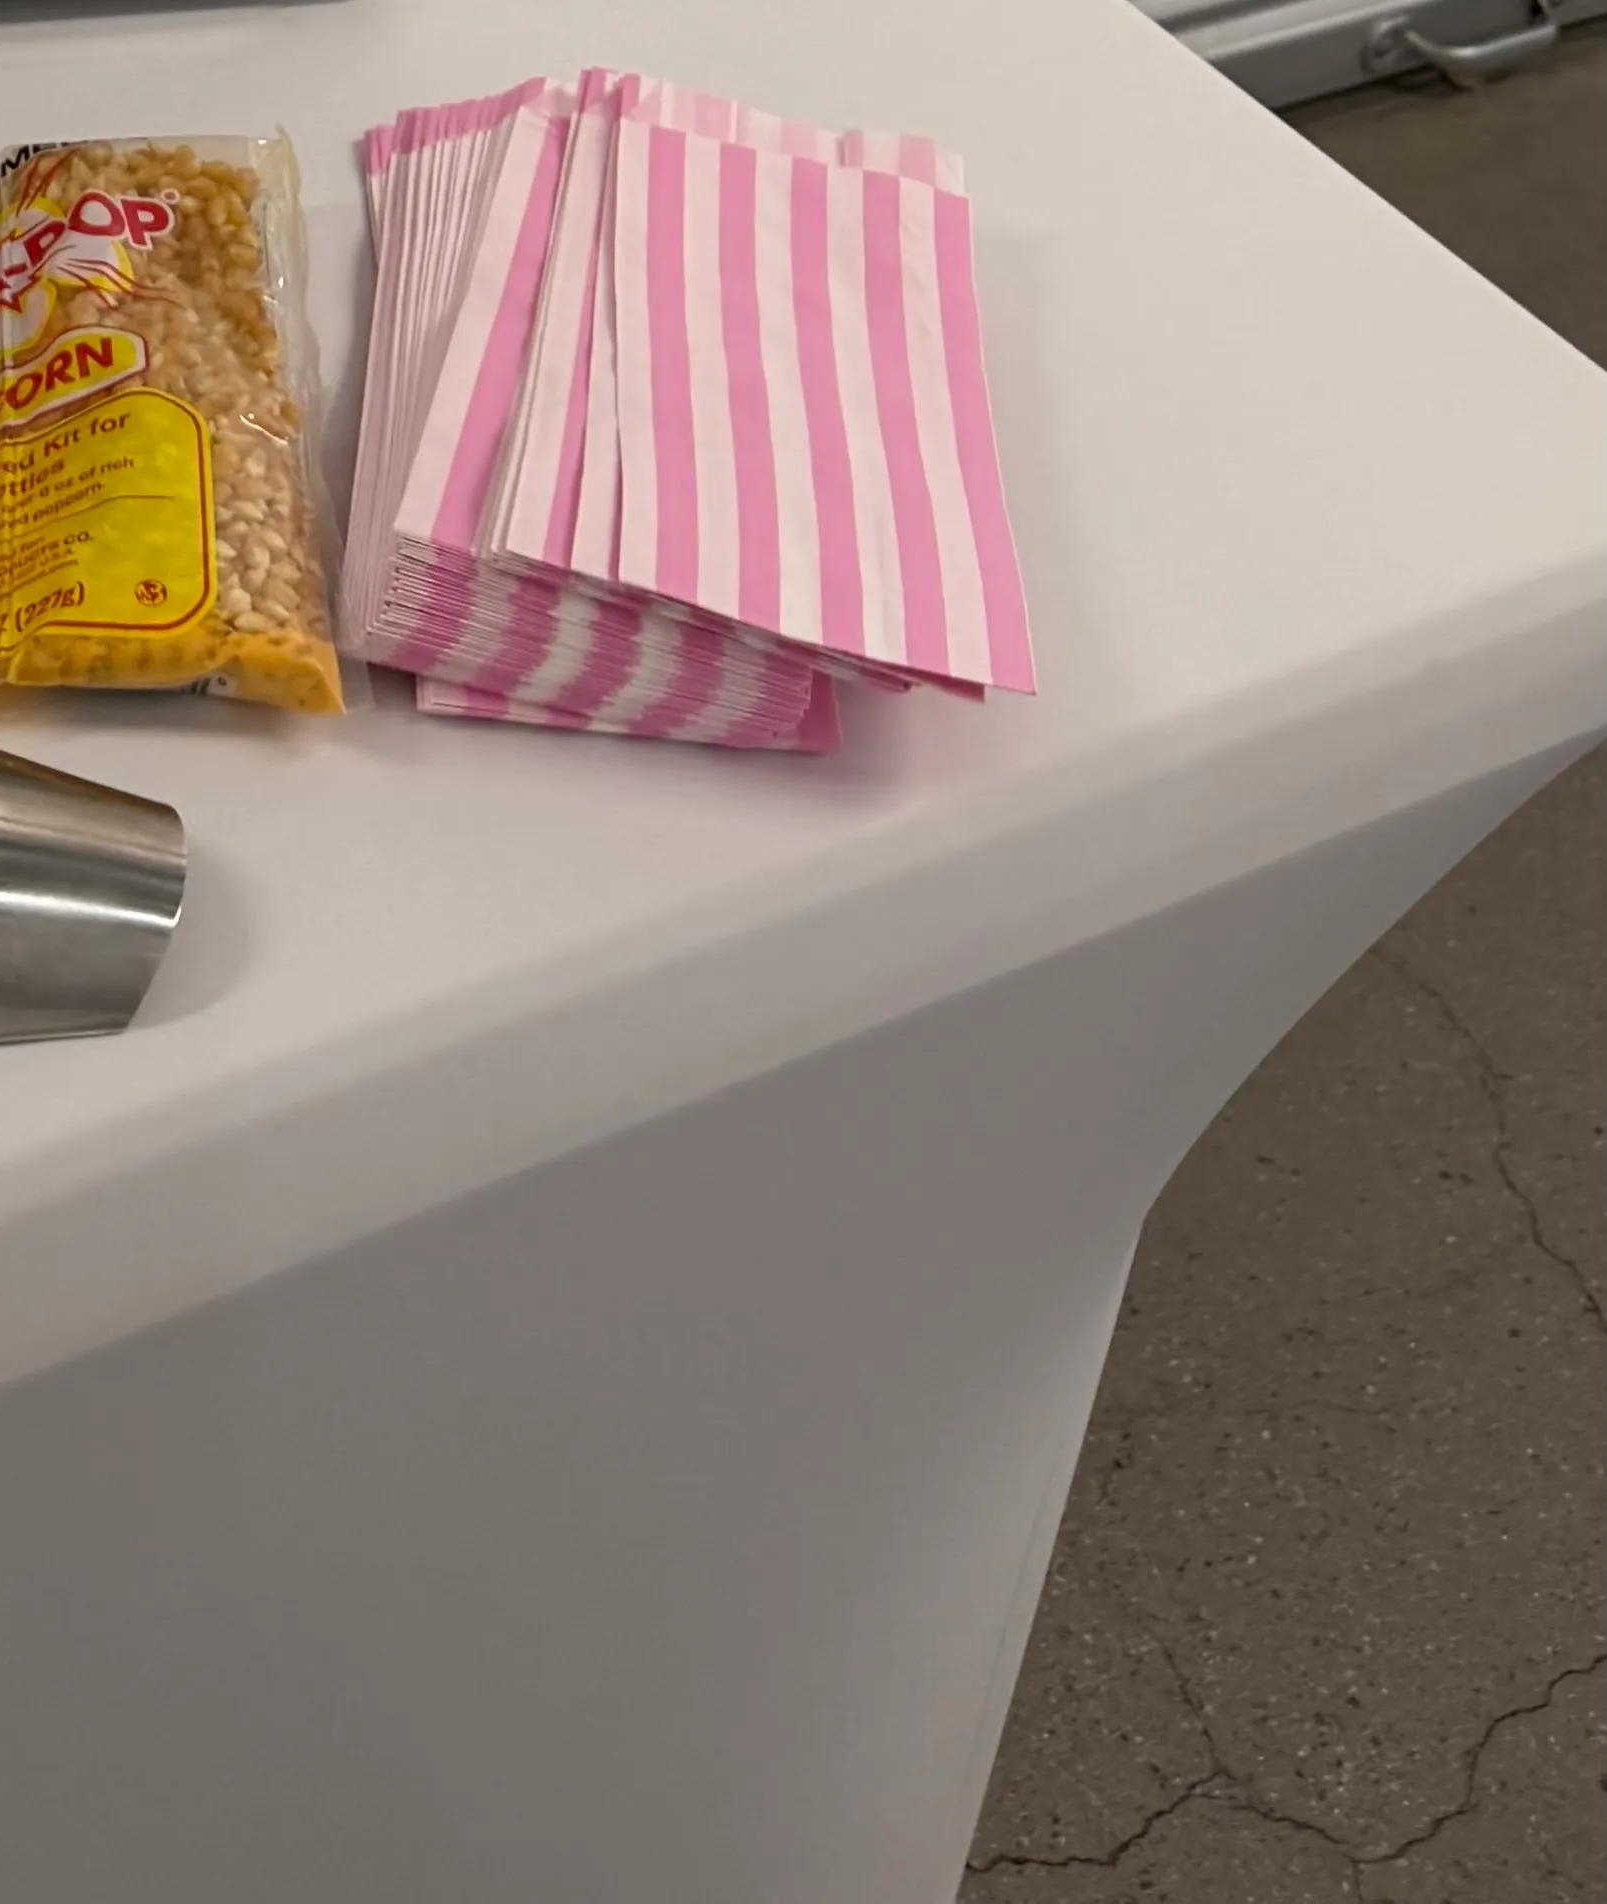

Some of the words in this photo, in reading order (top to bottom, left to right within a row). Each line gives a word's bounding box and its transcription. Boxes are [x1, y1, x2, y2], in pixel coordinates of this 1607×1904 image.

[43, 428, 81, 457] Kit
[90, 413, 131, 436] for
[15, 580, 85, 633] (227g)
